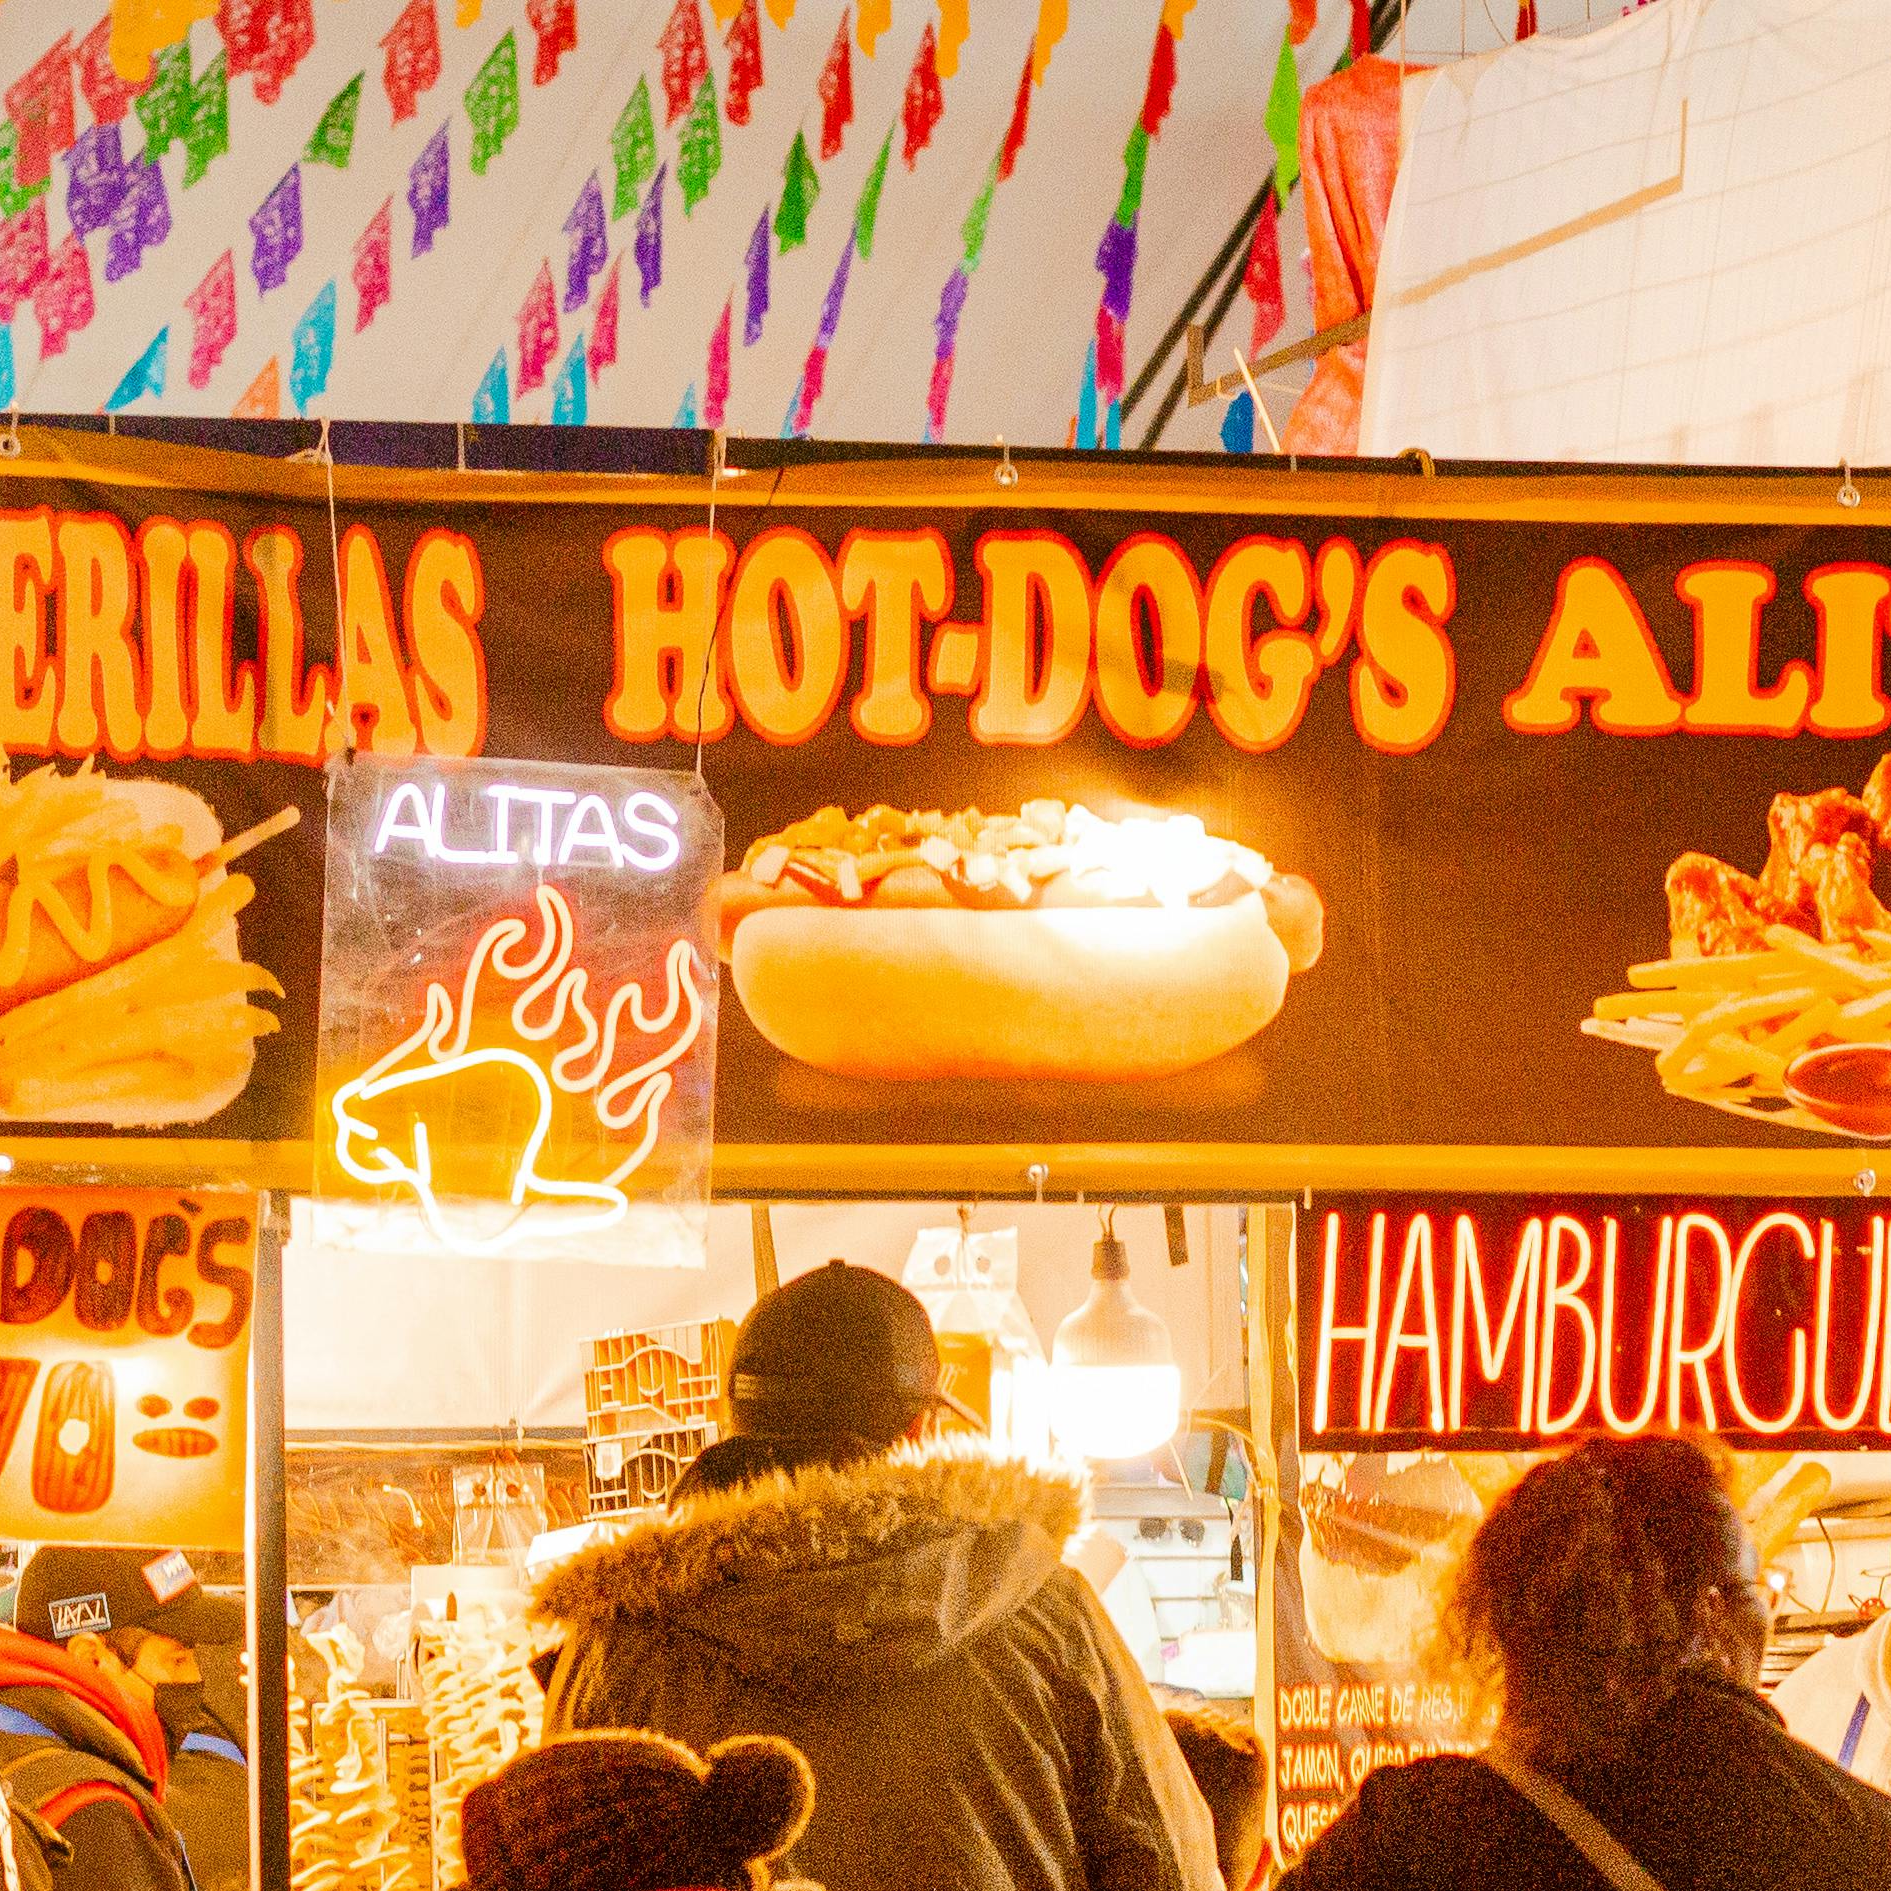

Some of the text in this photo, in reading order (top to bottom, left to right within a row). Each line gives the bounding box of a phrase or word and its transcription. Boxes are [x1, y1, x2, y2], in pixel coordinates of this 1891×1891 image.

[603, 524, 1456, 754] HOT-DOG'S
[374, 782, 681, 872] ALITAS
[1279, 1686, 1332, 1728] DOBLE
[1336, 1685, 1385, 1724] CARNE
[1390, 1683, 1417, 1722] DE
[1281, 1743, 1344, 1794] JAMON,
